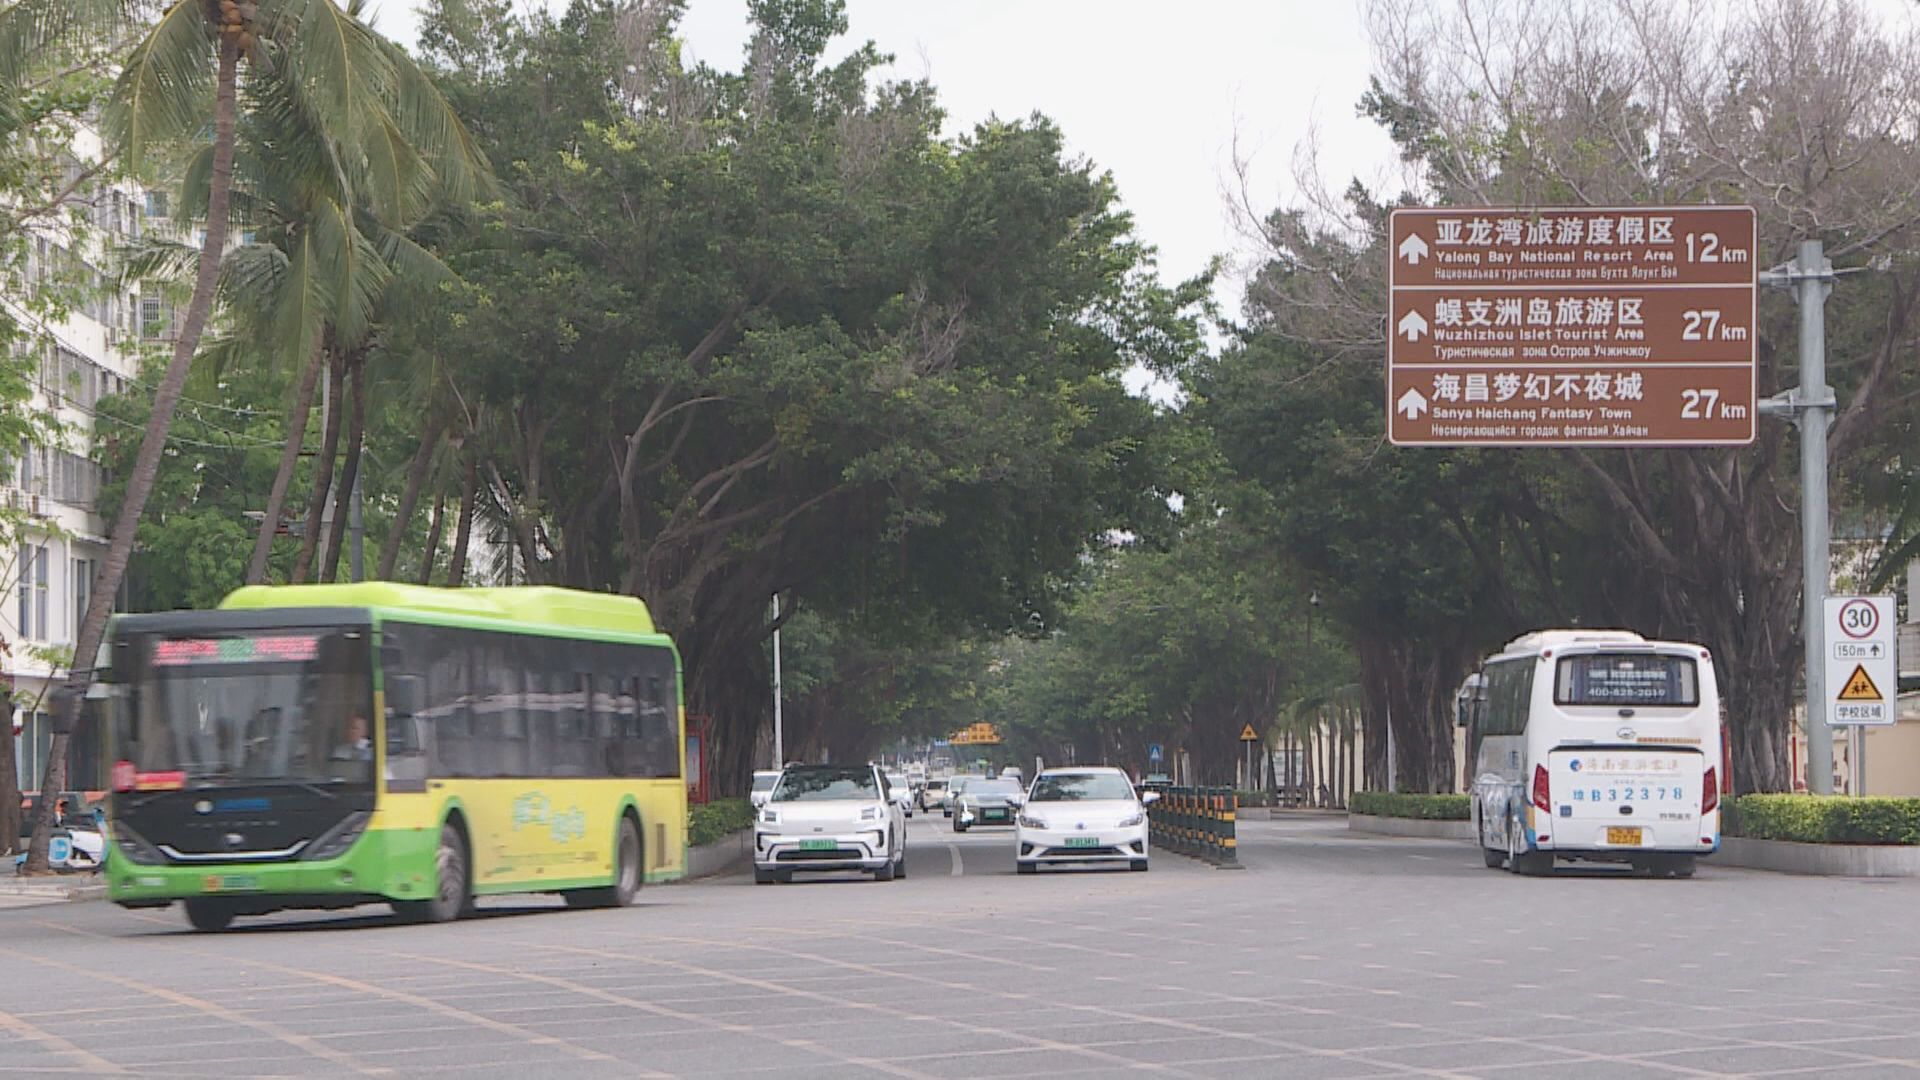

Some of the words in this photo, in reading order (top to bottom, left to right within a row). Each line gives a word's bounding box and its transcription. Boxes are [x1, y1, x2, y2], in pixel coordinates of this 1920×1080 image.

[1435, 217, 1674, 246] 亚龙湾旅游度假区
[1436, 250, 1480, 265] Yalong
[1488, 250, 1513, 264] Bay
[1520, 250, 1576, 263] National
[1583, 250, 1633, 263] Resort
[1644, 249, 1674, 262] Area
[1575, 268, 1598, 279] зона
[1601, 265, 1629, 280] Бухта
[1434, 297, 1644, 326] 蜈支洲岛旅游区
[1434, 328, 1514, 341] Wuzhizhou
[1519, 328, 1552, 341] Islet
[1555, 327, 1608, 341] Tourist
[1615, 327, 1645, 340] Area
[1522, 347, 1548, 357] зона
[1550, 344, 1591, 360] Остров
[1431, 373, 1644, 402] 海昌梦幻不夜城
[1432, 407, 1473, 421] Sanya
[1475, 406, 1537, 422] Haichang
[1541, 406, 1594, 421] Fantasy
[1599, 406, 1632, 419] Town
[1847, 608, 1872, 628] 30
[1838, 645, 1866, 656] 150m
[1838, 706, 1882, 718] 学校区域
